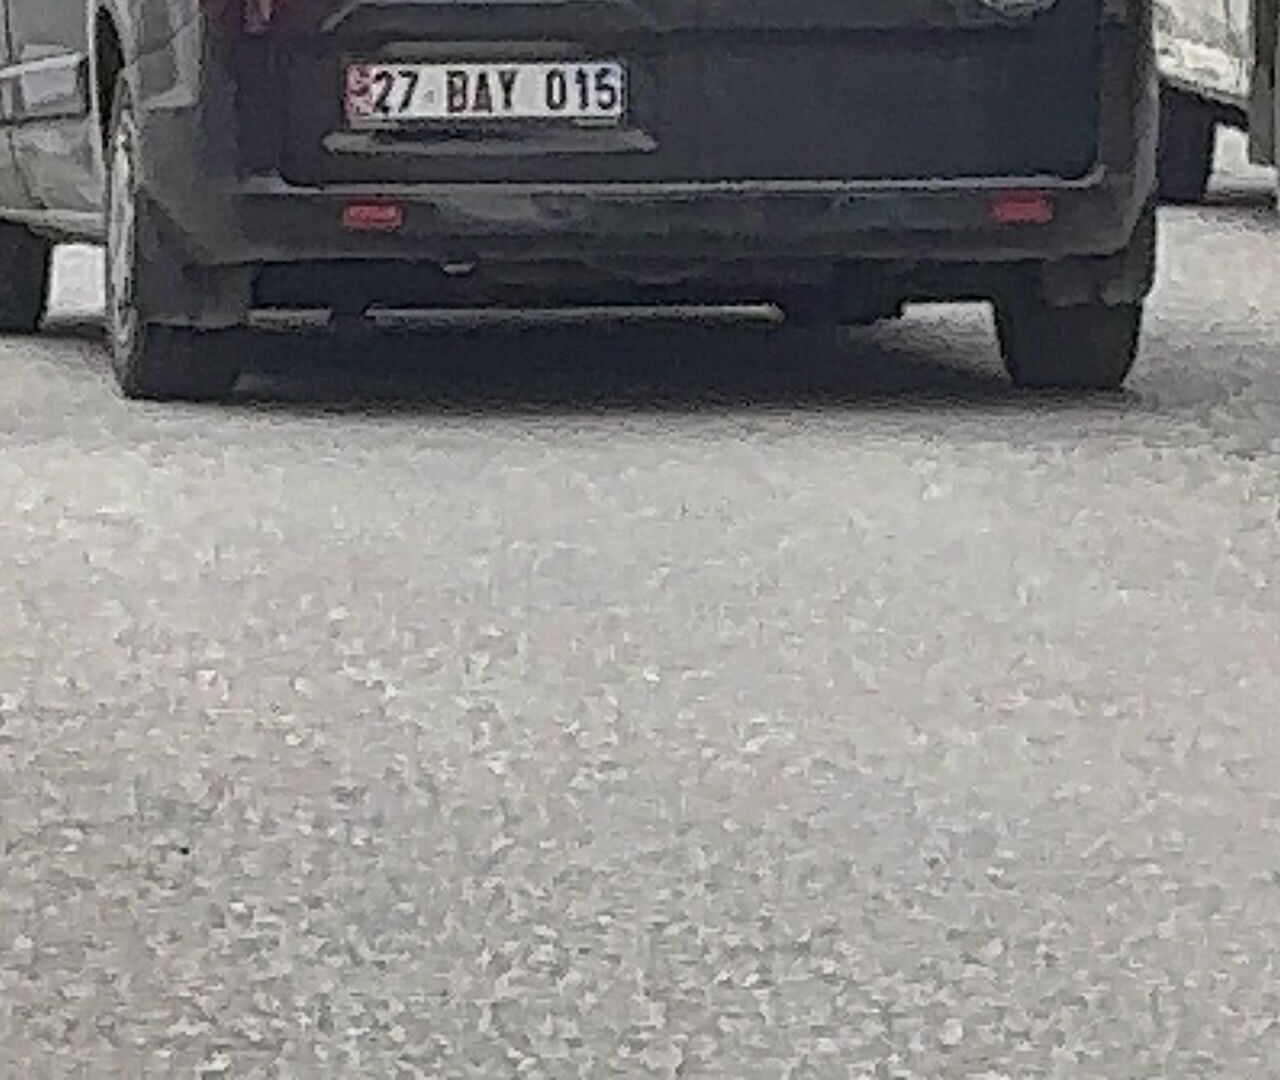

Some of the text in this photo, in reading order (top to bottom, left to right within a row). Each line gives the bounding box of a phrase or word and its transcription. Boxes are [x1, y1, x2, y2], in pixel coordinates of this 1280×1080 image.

[372, 67, 617, 113] 27 BAY 015
